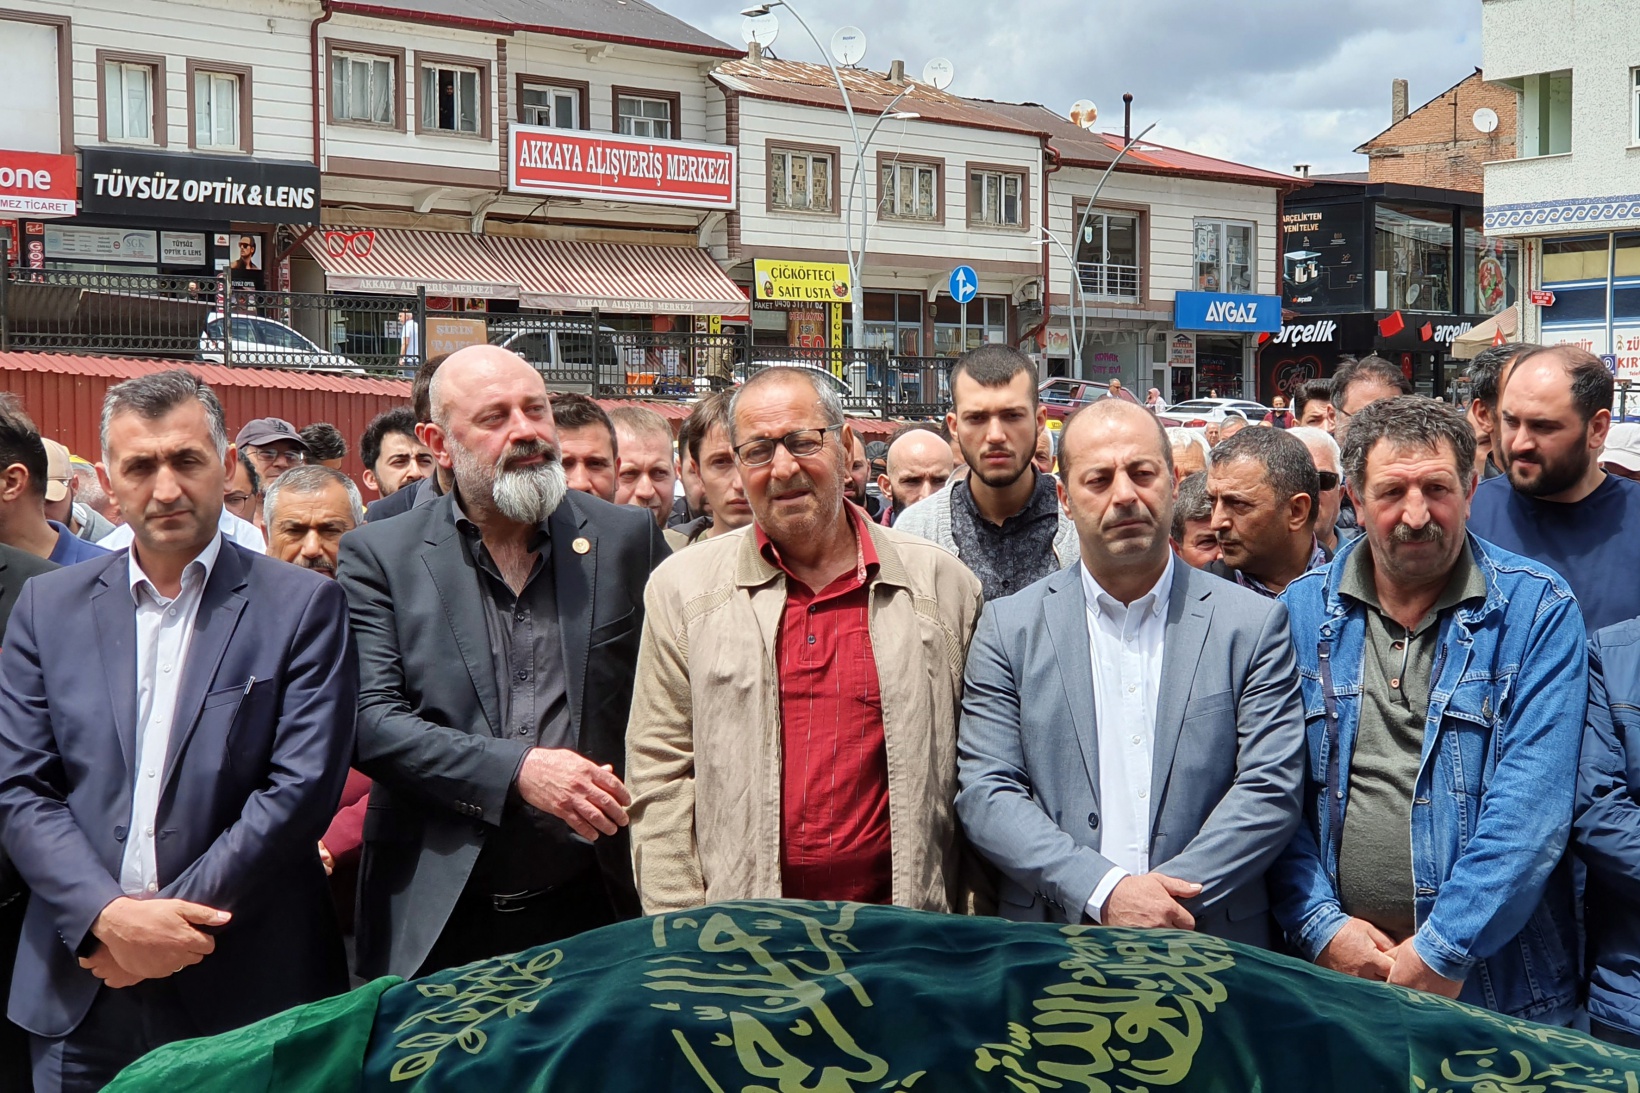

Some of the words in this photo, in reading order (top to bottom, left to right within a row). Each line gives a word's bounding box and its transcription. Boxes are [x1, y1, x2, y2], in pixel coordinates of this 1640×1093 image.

[520, 140, 582, 171] AKKAYA
[587, 146, 663, 186] ALIŞVERİŞ
[667, 153, 730, 185] MERKEZİ
[93, 168, 180, 200] TÜYSÜZ
[182, 176, 247, 205] OPTİK
[247, 185, 263, 206] &
[265, 185, 315, 209] LENS
[24, 200, 68, 211] TİCARET
[1284, 223, 1299, 233] YENİ
[1300, 223, 1319, 231] TELVE
[127, 239, 145, 248] SGK
[164, 248, 181, 256] OPTİK
[771, 264, 835, 282] ÇİĞKÖFTECİ
[360, 279, 396, 290] AKKAYA
[452, 284, 494, 295] MERKEZİ
[778, 284, 801, 298] SAİT
[805, 287, 831, 299] USTA
[576, 299, 608, 308] AKKAYA
[611, 299, 654, 311] ALIŞVERİŞ
[657, 301, 694, 312] MERKEZİ
[754, 301, 773, 310] PAKET
[1205, 301, 1258, 323] AYGAZ
[1273, 320, 1337, 347] arçelik
